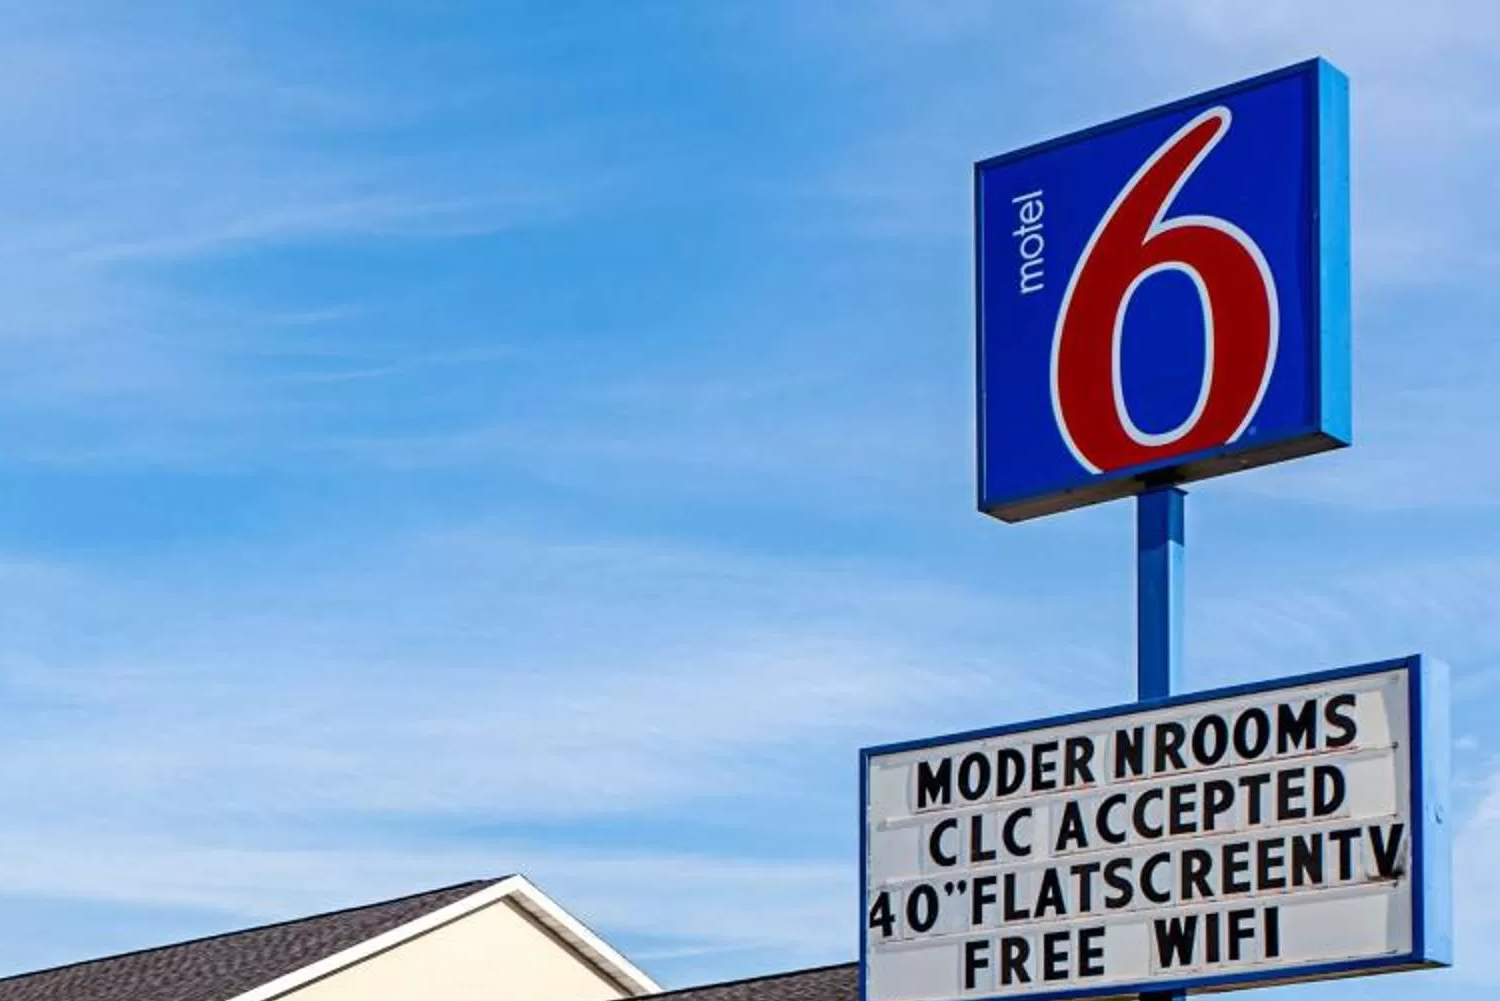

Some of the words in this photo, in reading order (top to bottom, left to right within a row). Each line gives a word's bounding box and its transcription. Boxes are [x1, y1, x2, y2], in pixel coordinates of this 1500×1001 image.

[1012, 189, 1045, 294] motel
[1049, 105, 1280, 475] 6
[929, 807, 1033, 868] CLC
[1055, 764, 1346, 851] ACCEPTED
[964, 926, 1106, 990] FREE
[1154, 905, 1280, 969] WIFI
